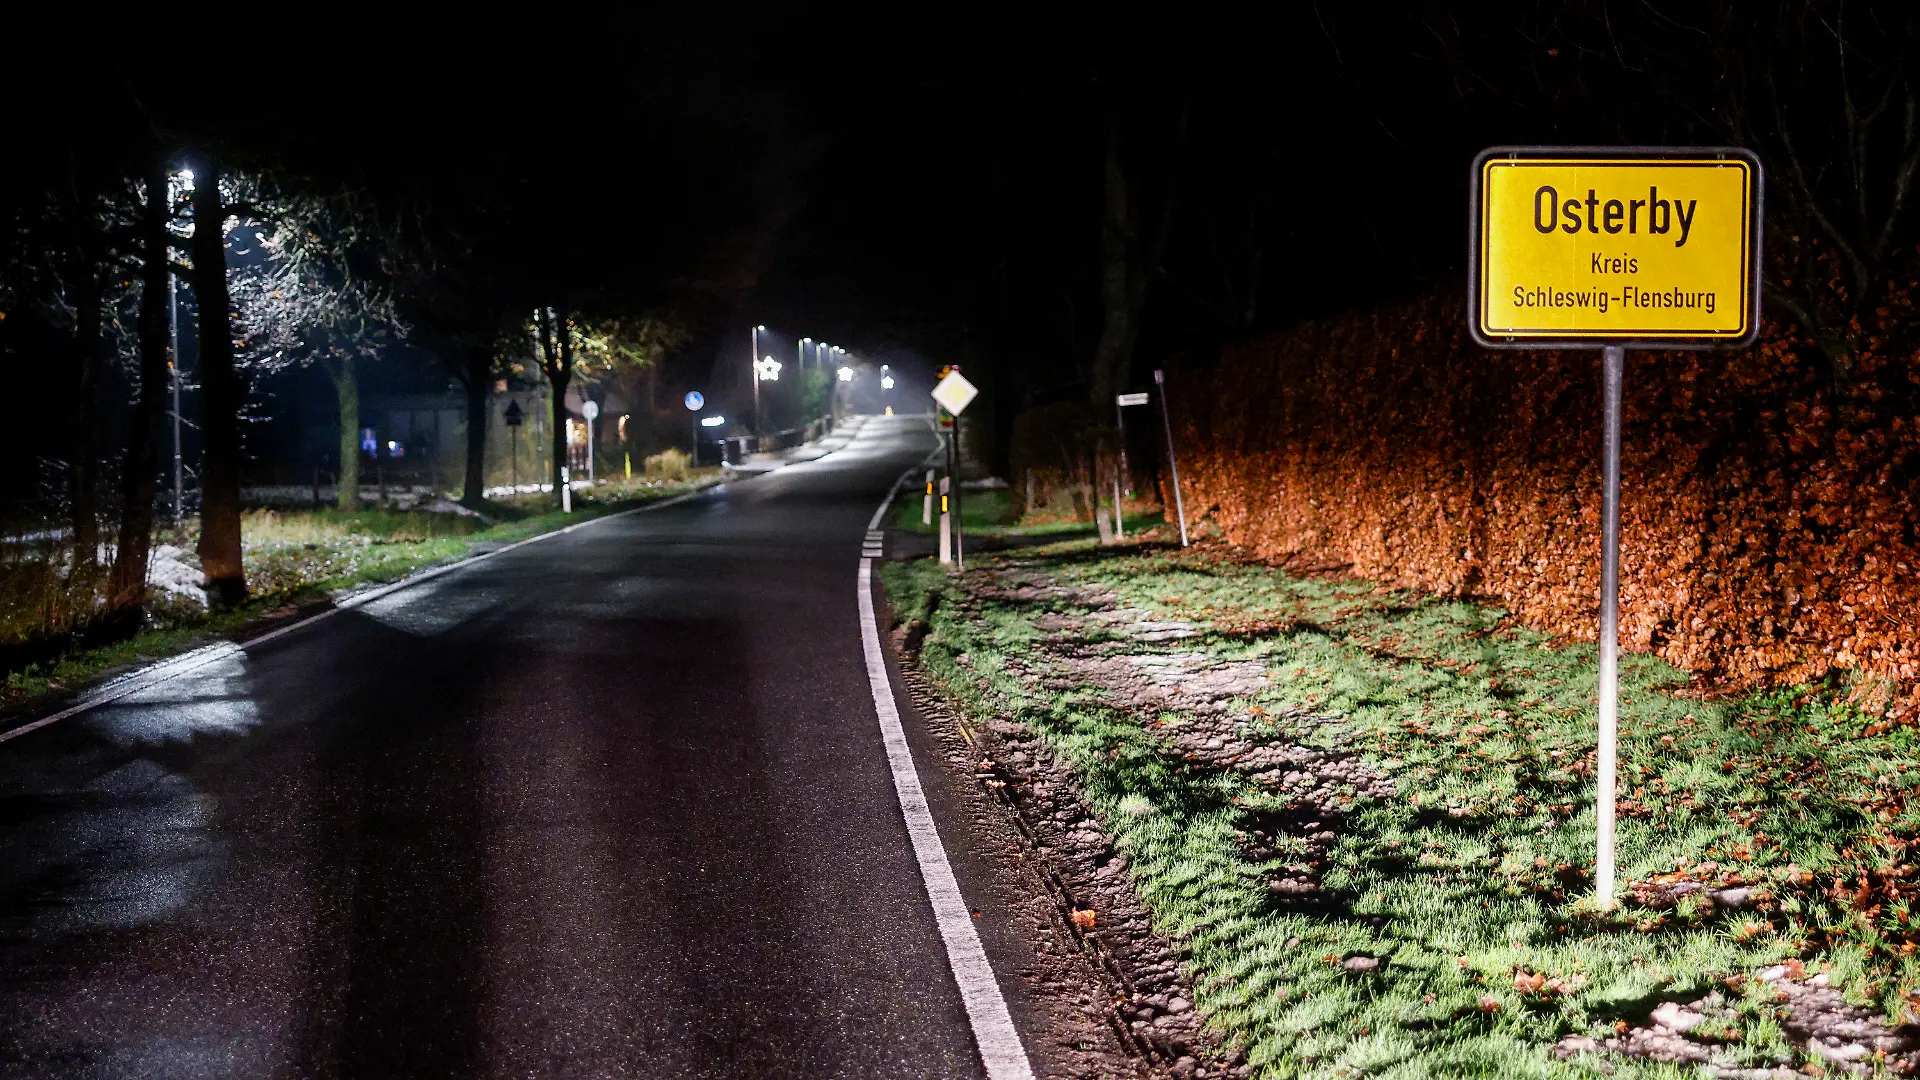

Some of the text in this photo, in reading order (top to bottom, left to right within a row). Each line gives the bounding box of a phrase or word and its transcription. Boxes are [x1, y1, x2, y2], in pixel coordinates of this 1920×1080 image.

[1534, 185, 1698, 248] Osterby
[1591, 252, 1638, 274] Kreis
[1513, 286, 1716, 314] Schleswig-Flensburg
